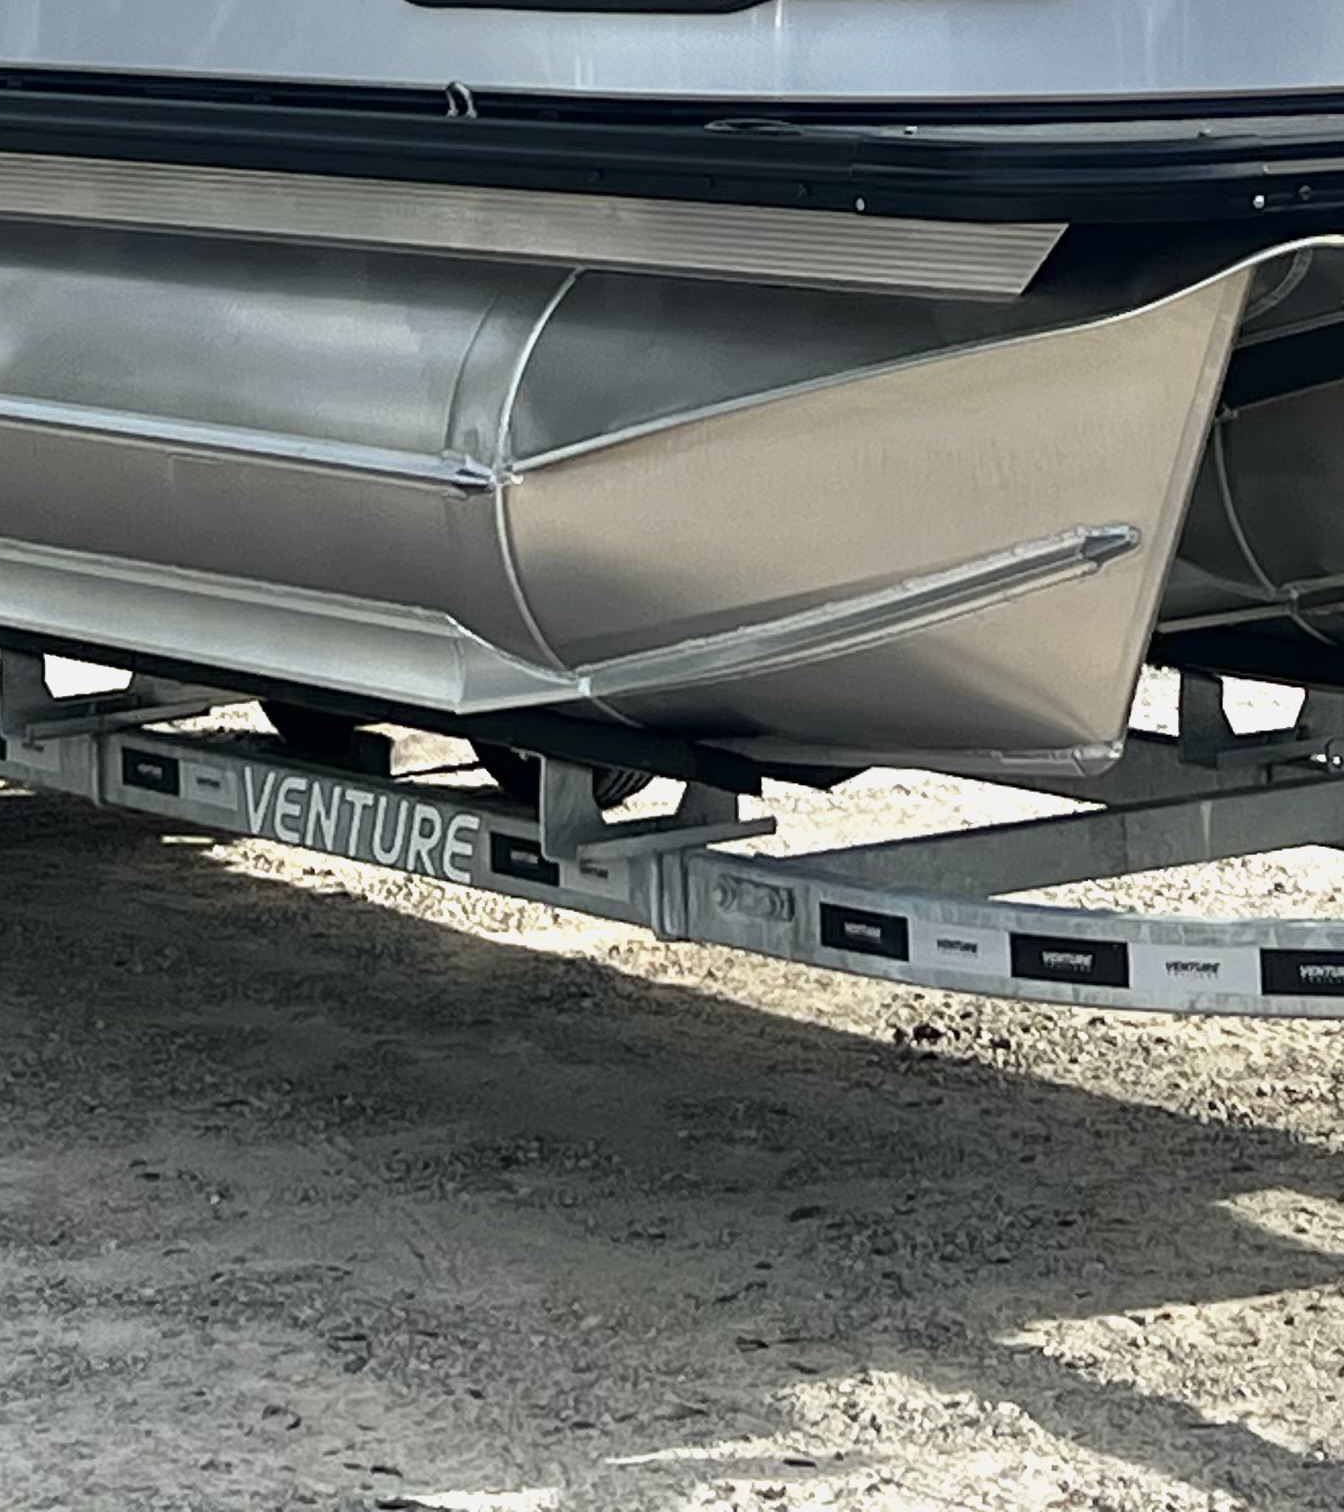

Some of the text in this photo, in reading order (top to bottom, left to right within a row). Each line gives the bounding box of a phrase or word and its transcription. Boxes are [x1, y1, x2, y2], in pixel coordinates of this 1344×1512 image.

[243, 765, 481, 885] VENTURE
[1041, 950, 1094, 968] VENTURE
[1165, 960, 1221, 974] VENTURE
